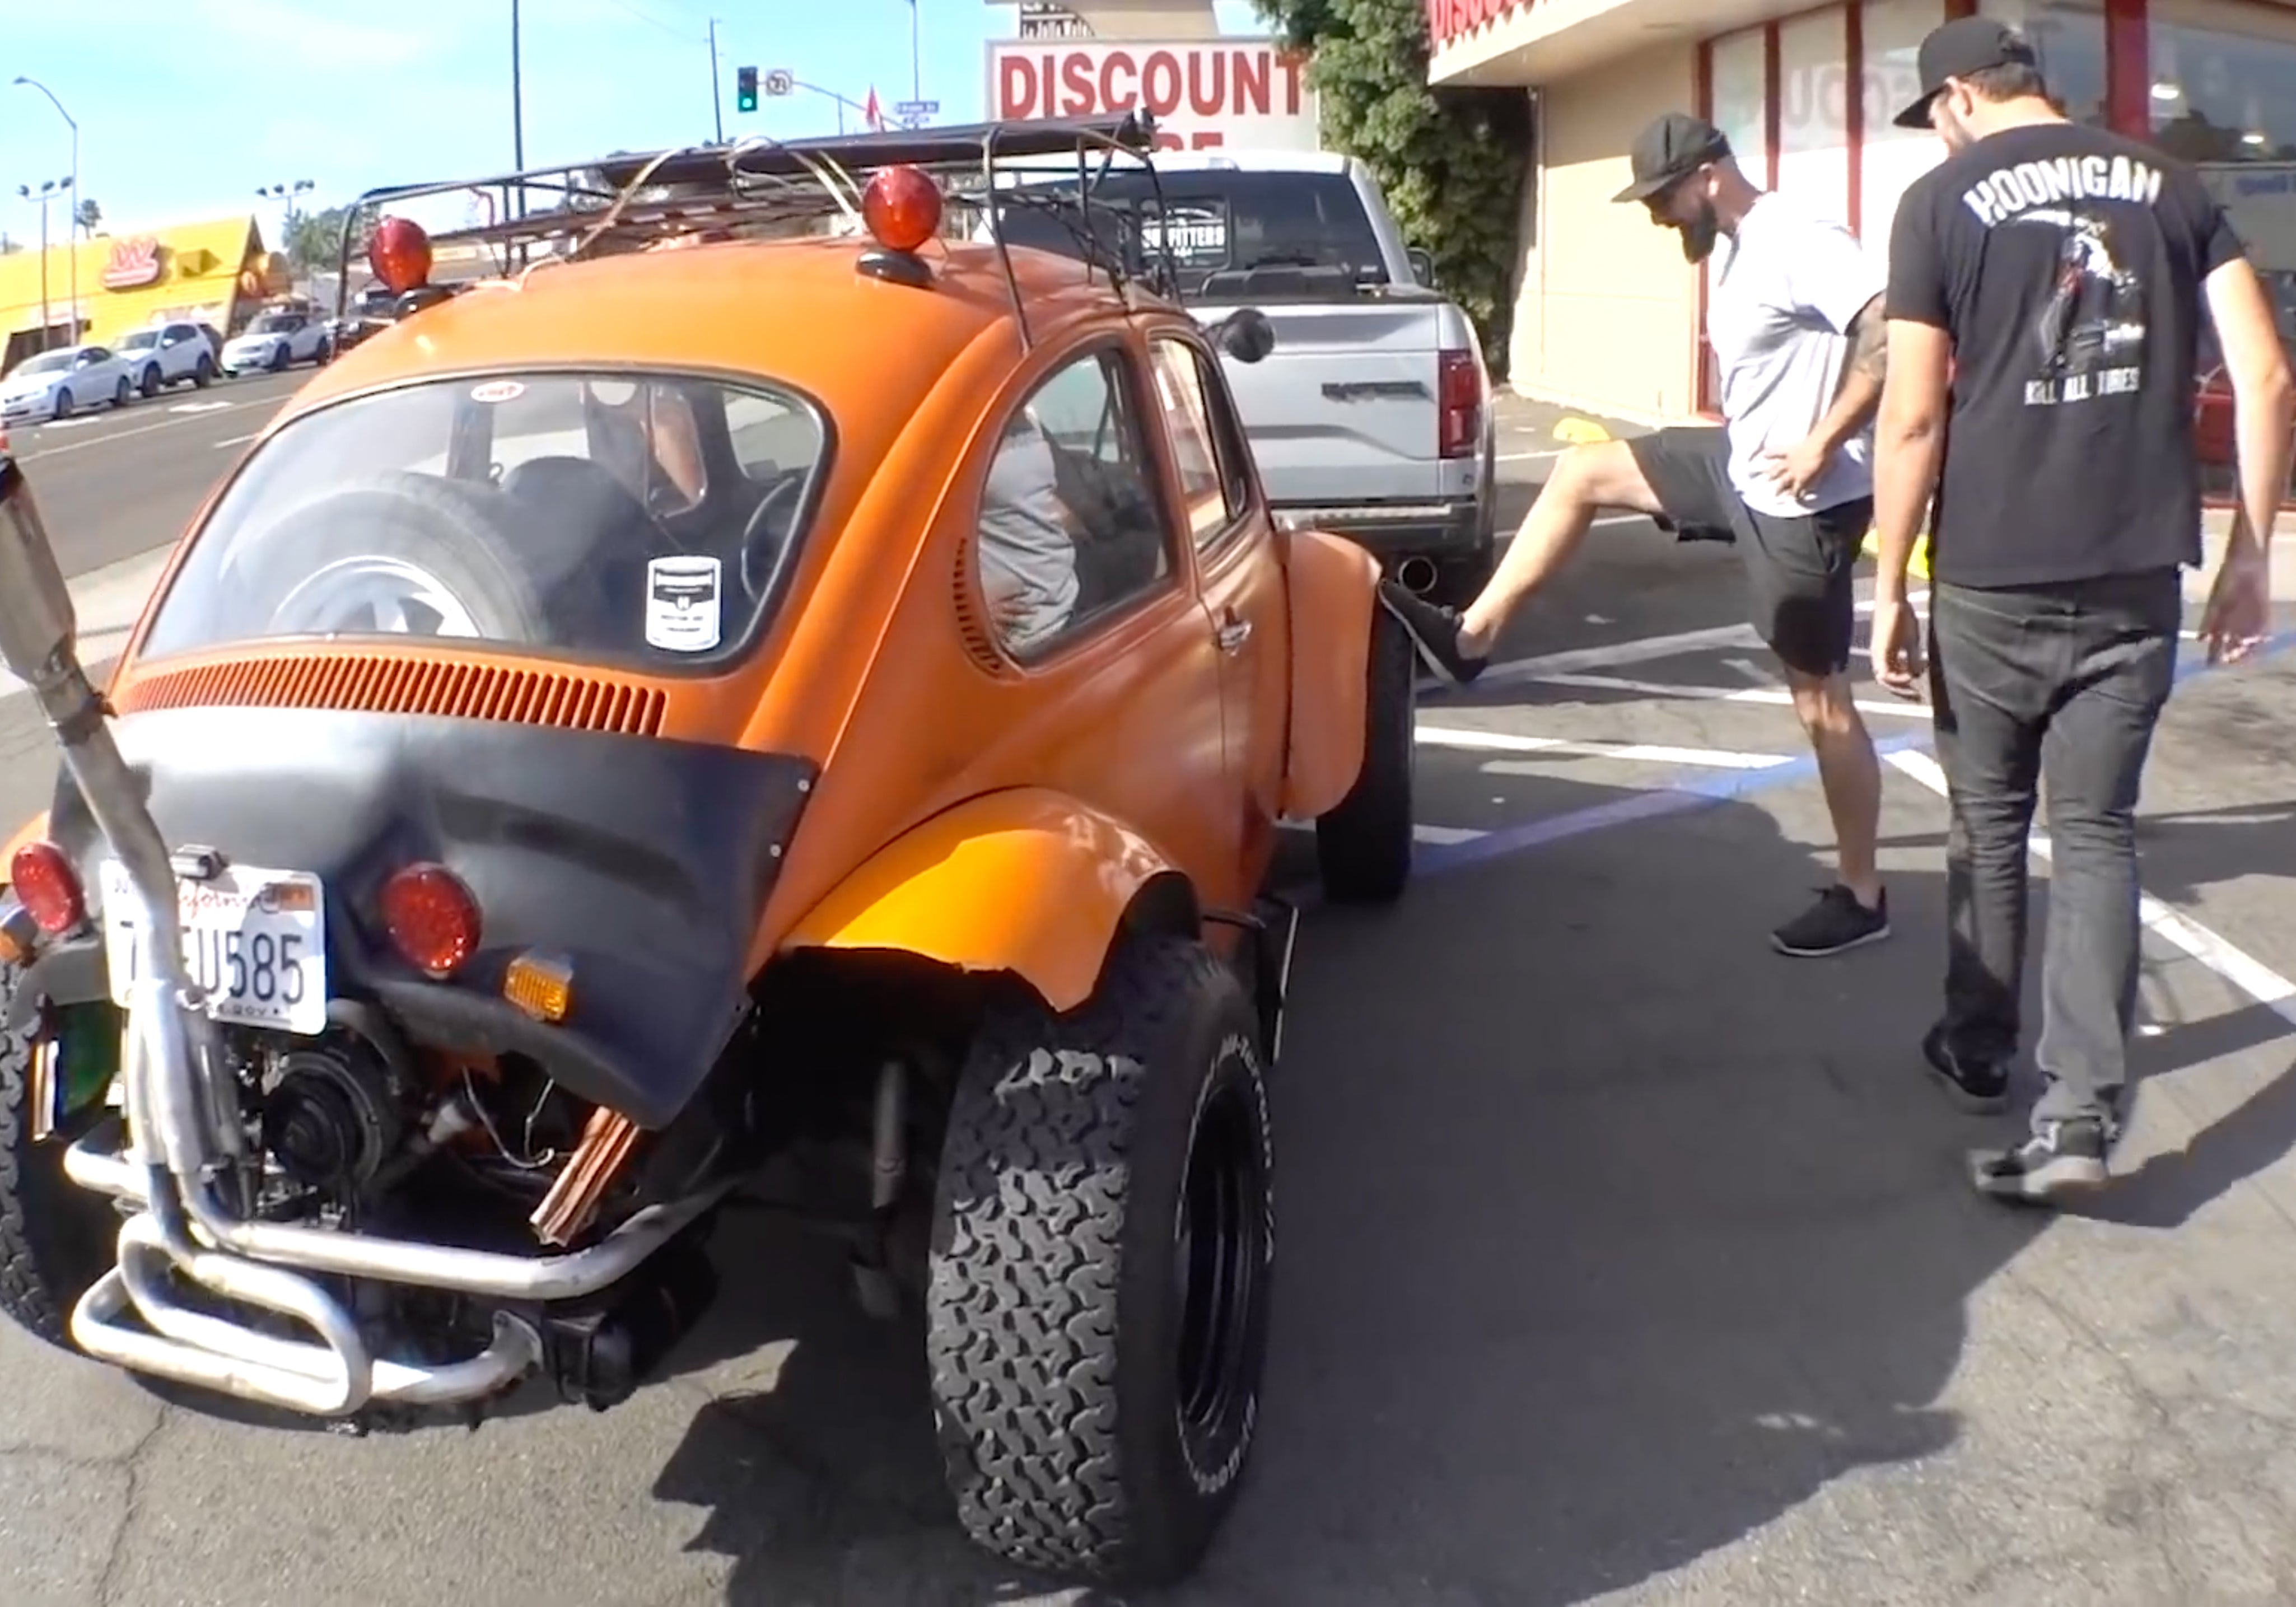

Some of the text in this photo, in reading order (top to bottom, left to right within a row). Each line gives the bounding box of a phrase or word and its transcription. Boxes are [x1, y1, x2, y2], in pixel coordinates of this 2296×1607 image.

[1000, 50, 1304, 120] DISCOUNT
[1962, 155, 2162, 227] HOONIGAN
[2062, 373, 2092, 402] ALL
[119, 918, 304, 1005] 7U585
